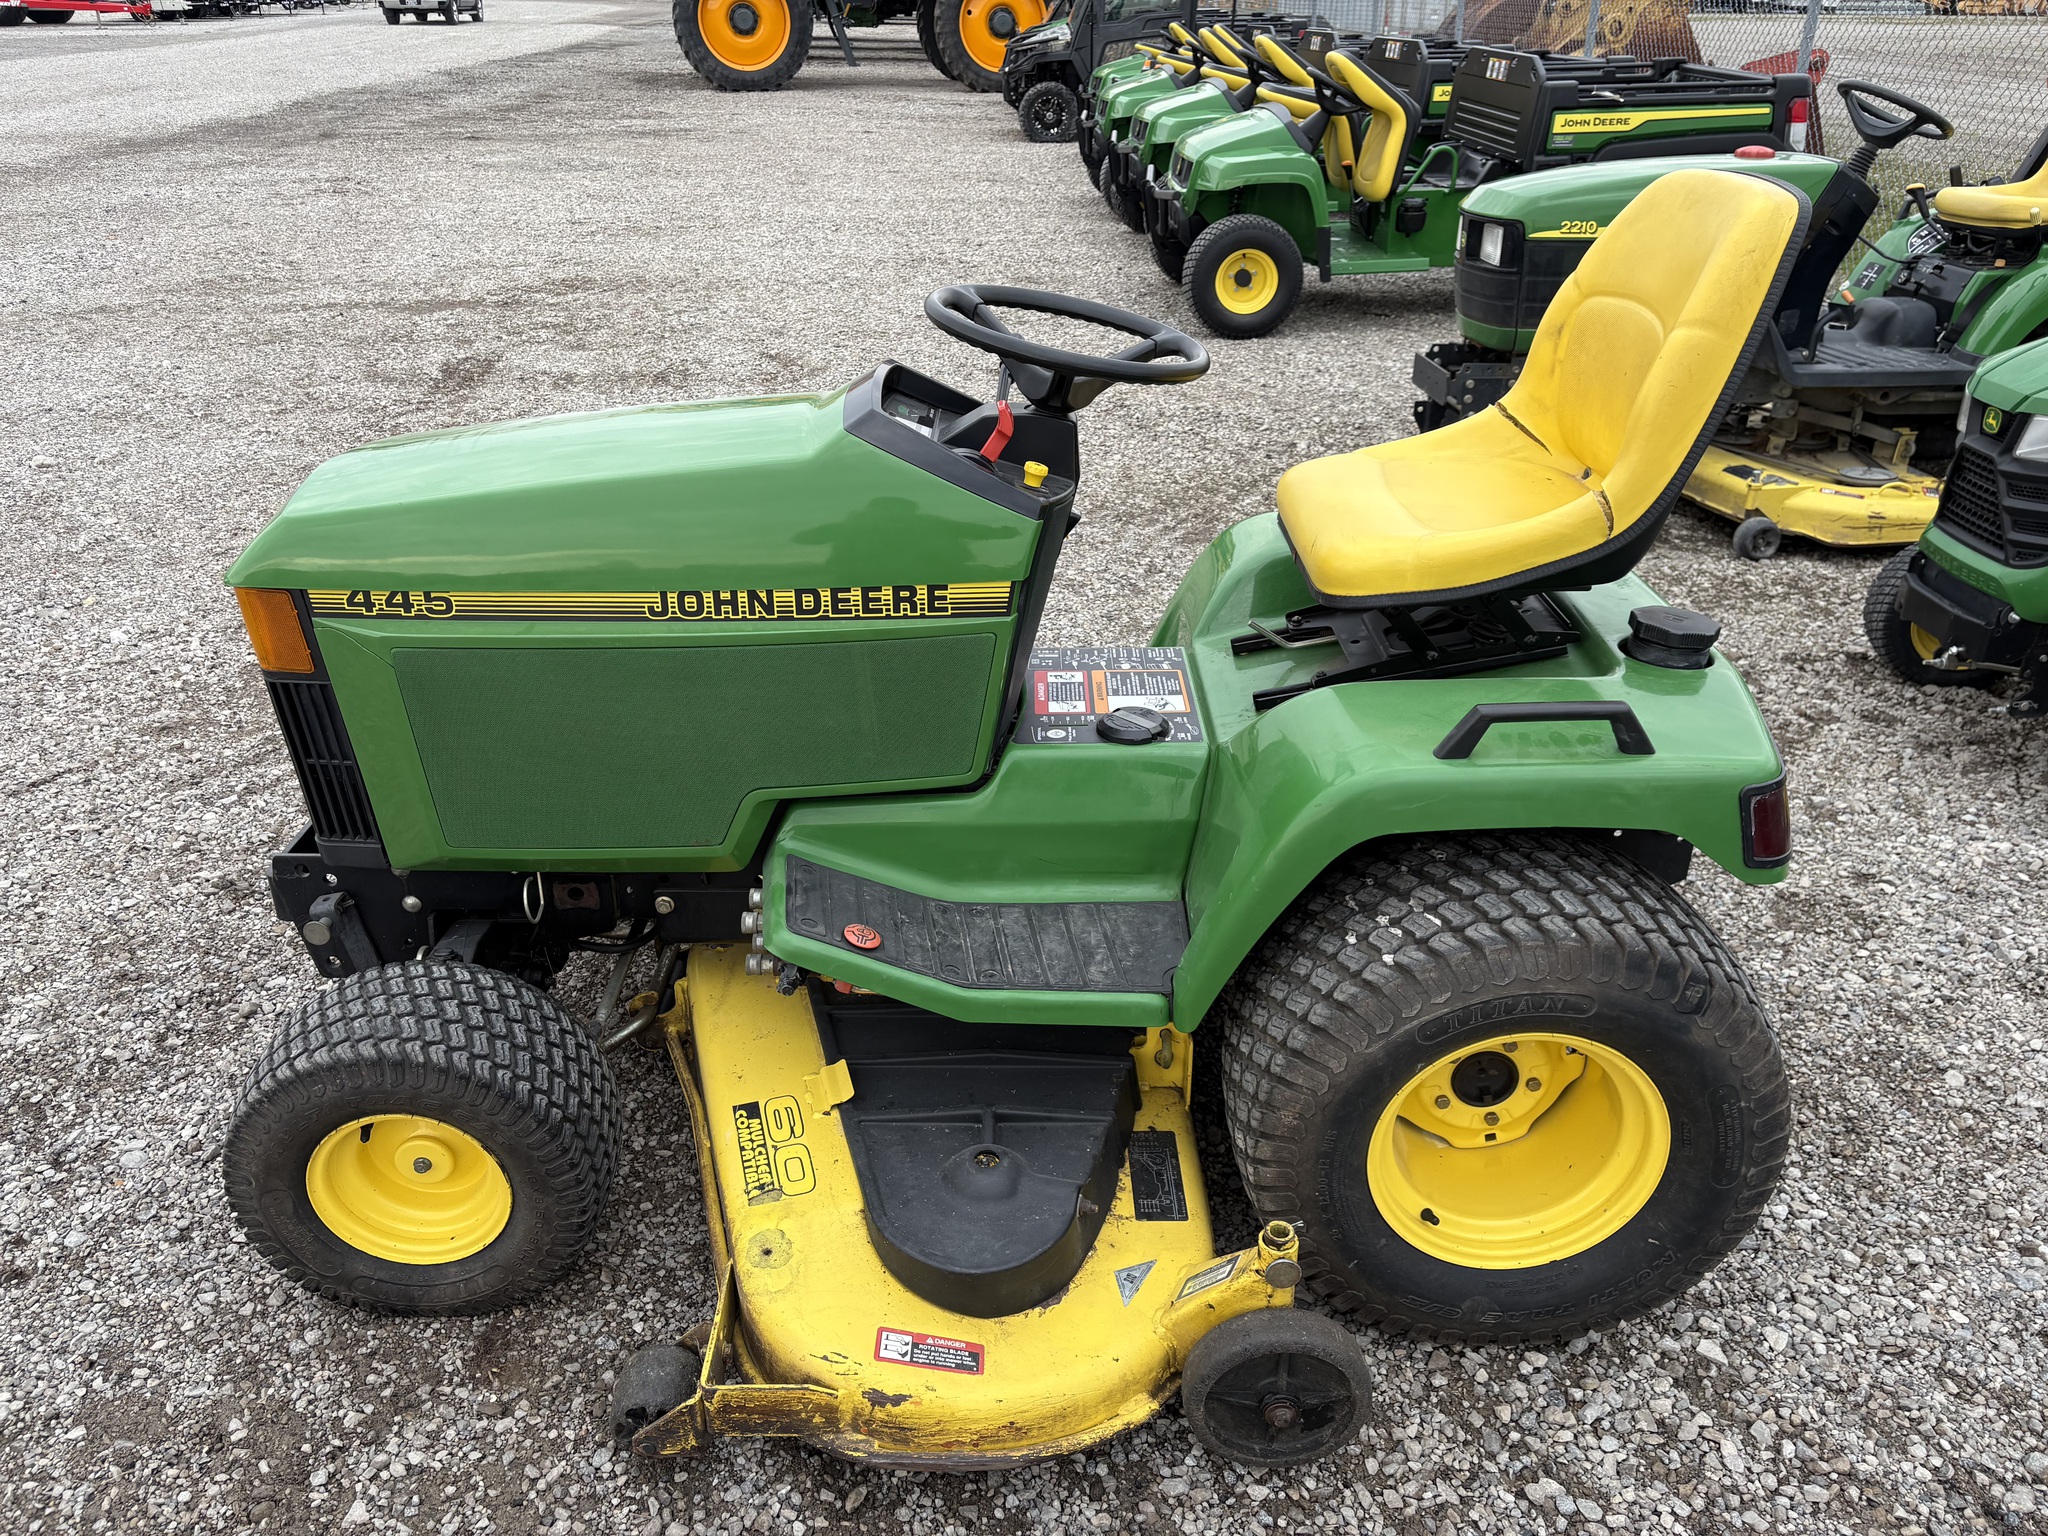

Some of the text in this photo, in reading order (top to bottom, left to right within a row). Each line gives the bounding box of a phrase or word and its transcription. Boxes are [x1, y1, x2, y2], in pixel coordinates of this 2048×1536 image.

[1560, 118, 1630, 128] JOHN DEERE
[1560, 221, 1598, 234] 2210
[1951, 561, 1997, 595] DEERE
[344, 590, 455, 618] 445
[645, 584, 951, 620] JOHN DEERE
[1442, 996, 1568, 1033] TITAN
[735, 1109, 760, 1198] COMPATIBLE
[748, 1118, 774, 1184] MULCHER
[764, 1095, 817, 1196] 60
[1321, 1130, 1338, 1152] NHS
[378, 1275, 491, 1304] TITAN
[1587, 1250, 1676, 1308] MULTI
[919, 1344, 949, 1353] ROTATING
[934, 1338, 966, 1348] DANGER
